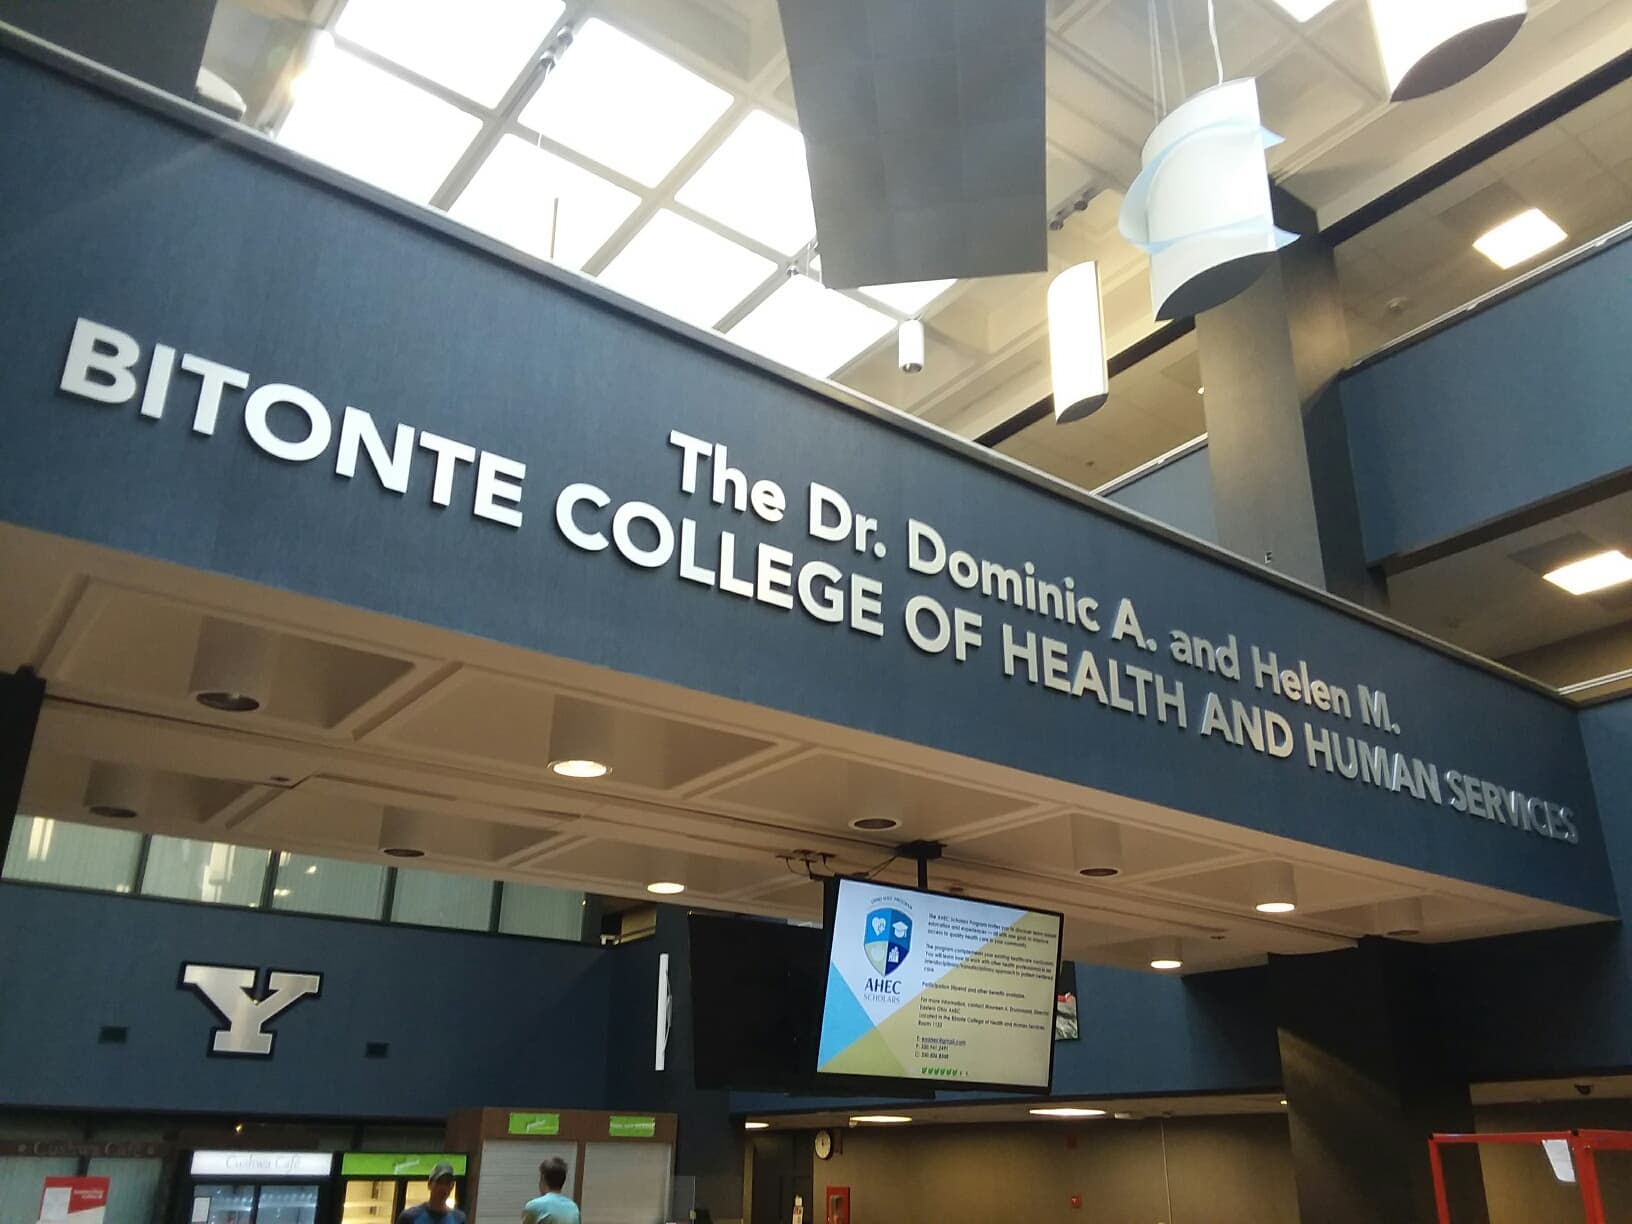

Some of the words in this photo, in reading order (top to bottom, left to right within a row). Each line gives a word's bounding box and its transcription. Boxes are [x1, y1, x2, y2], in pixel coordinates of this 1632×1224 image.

[60, 317, 526, 527] BITONTE
[556, 482, 884, 636] COLLEGE
[905, 596, 982, 661] OF
[1002, 624, 1187, 728] HEALTH
[1200, 692, 1294, 758] AND
[1304, 723, 1442, 805] HUMAN
[1444, 770, 1579, 844] SERVICES
[670, 430, 786, 523] The
[809, 481, 887, 559] Dr.
[907, 518, 1100, 632] Dominic
[1111, 598, 1157, 652] A.
[1169, 629, 1240, 681] and
[1251, 645, 1352, 718] Helen
[1357, 684, 1402, 735] M.
[180, 961, 323, 1058] Y
[865, 978, 902, 995] AHEC
